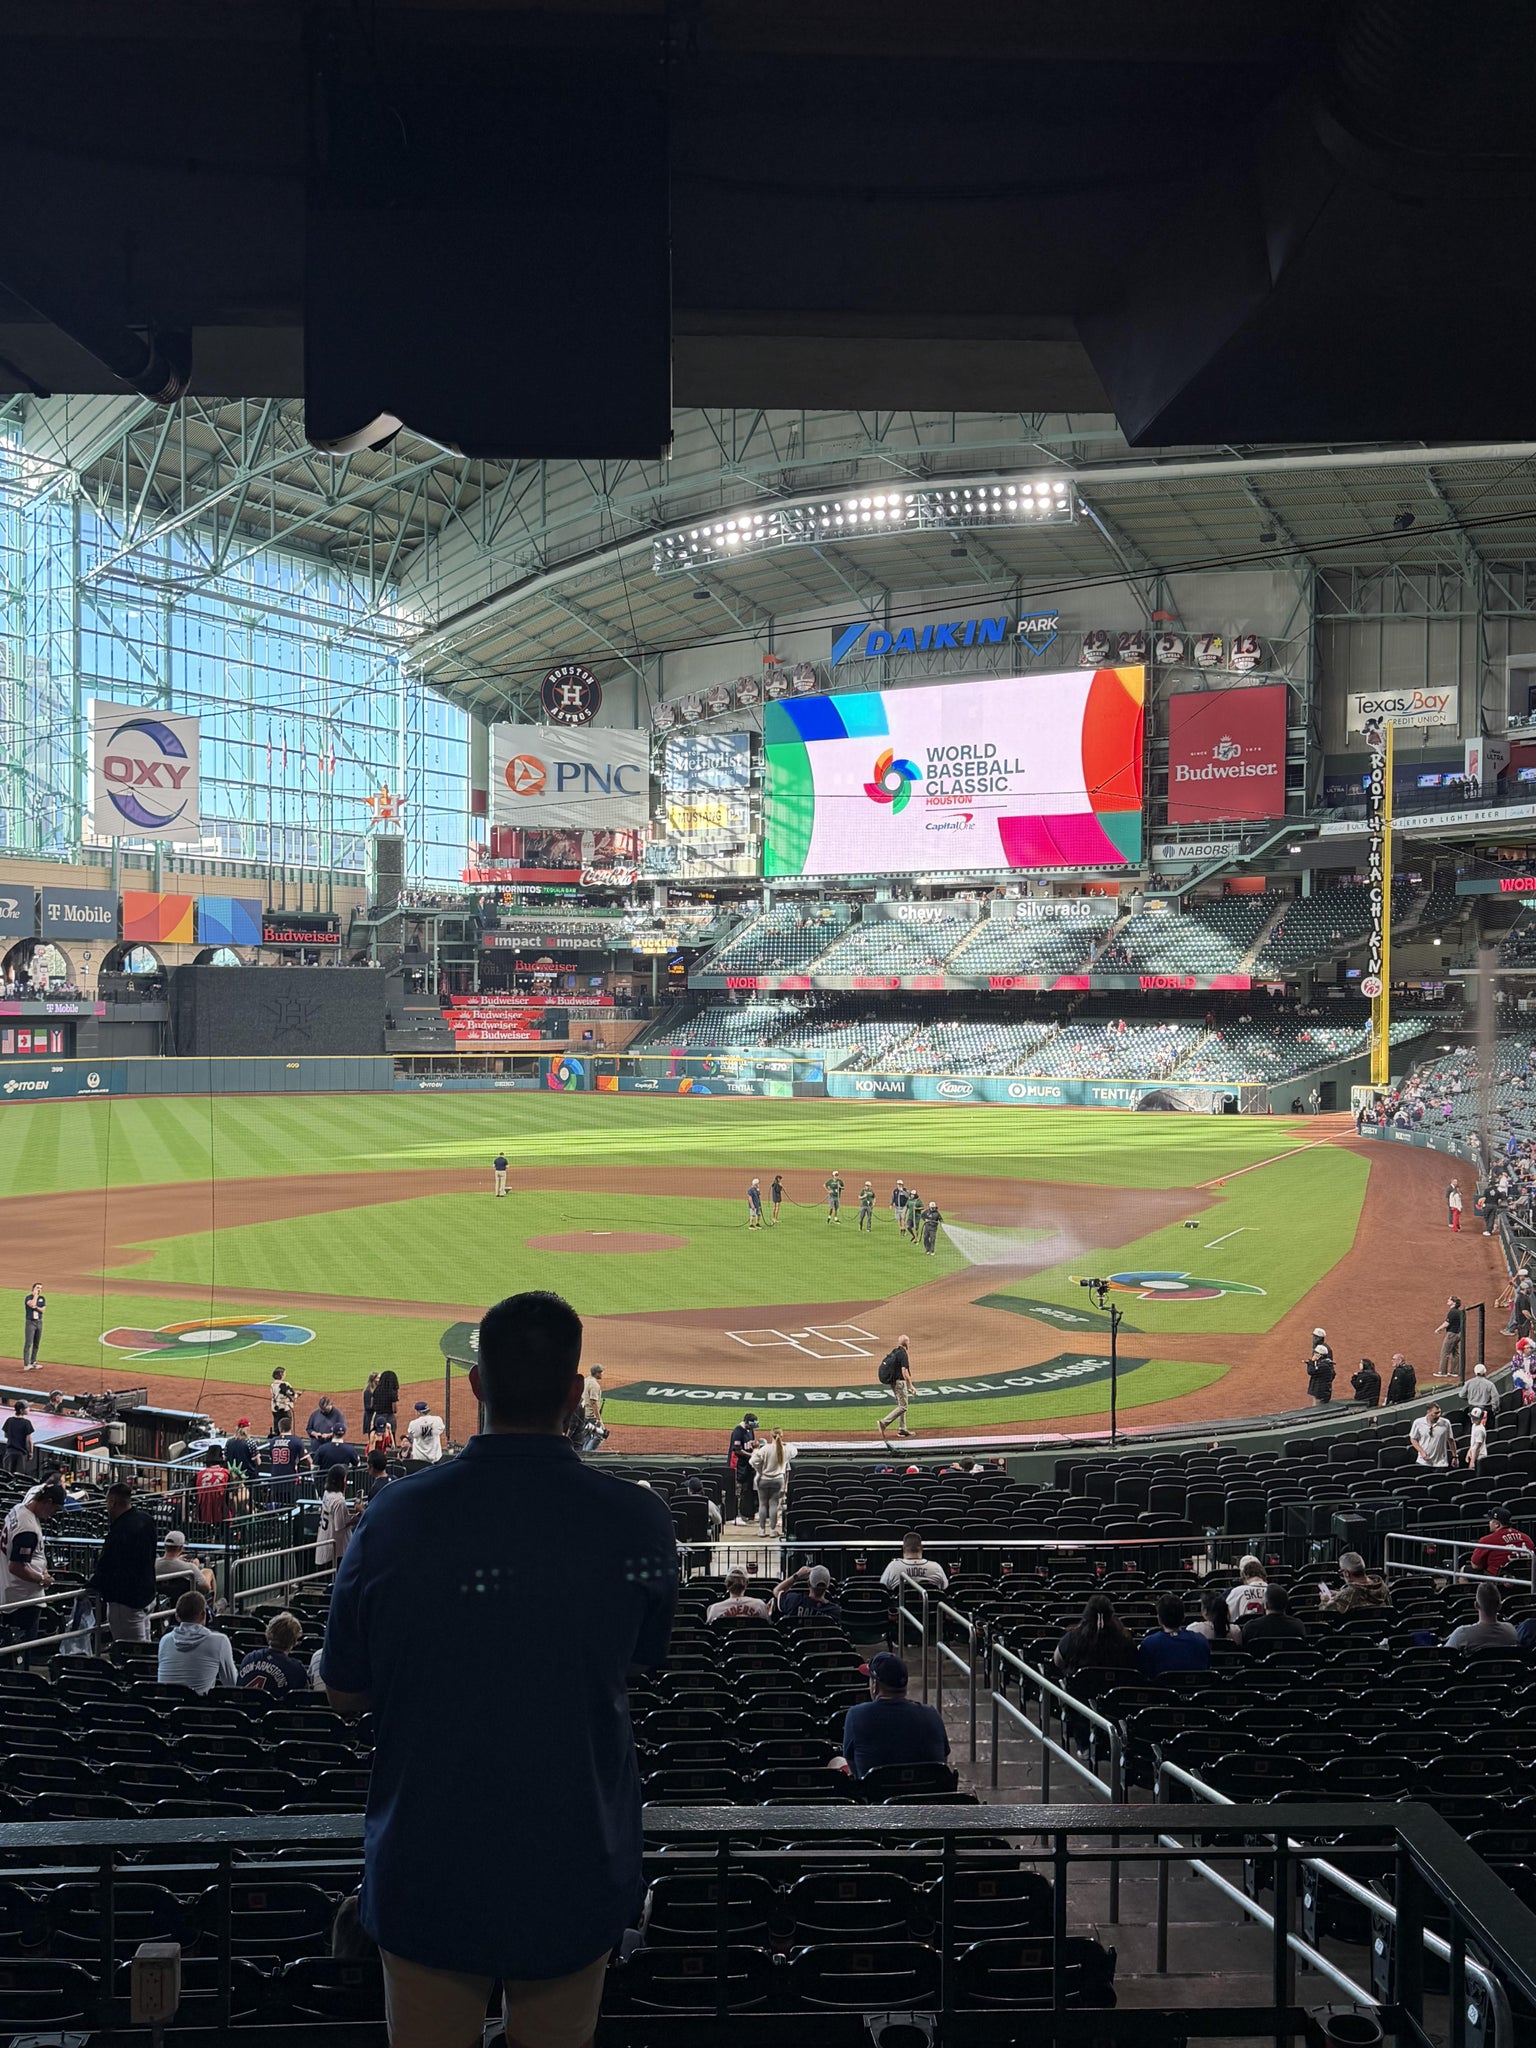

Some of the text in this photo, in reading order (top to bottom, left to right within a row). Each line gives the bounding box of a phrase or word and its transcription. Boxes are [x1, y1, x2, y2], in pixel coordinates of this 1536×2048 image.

[1017, 617, 1059, 633] PARK
[865, 617, 1008, 656] DAIKIN
[1083, 630, 1107, 649] 49
[1118, 630, 1143, 651] 24
[1163, 633, 1174, 651] 5
[1202, 632, 1214, 653] 7
[1234, 634, 1258, 654] 13
[549, 666, 595, 685] HOUSTON
[561, 685, 582, 705] H
[1355, 691, 1450, 714] Texas Bay
[550, 707, 592, 723] ASTROS
[1417, 715, 1447, 724] UNION
[926, 743, 997, 763] WORLD
[104, 756, 191, 789] OXY
[926, 758, 1025, 780] BASEBALL
[553, 762, 641, 795] PNC
[926, 776, 1008, 796] CLASSIC
[1370, 753, 1385, 810] ROOT
[926, 795, 973, 806] HOUSTON
[677, 811, 722, 823] MUSTANG
[1440, 814, 1468, 823] LIGHT
[1474, 811, 1499, 819] BEER
[1178, 845, 1229, 857] NABORS
[499, 886, 541, 894] HORNITOS
[64, 904, 112, 923] Mobile
[898, 905, 943, 920] Chevy
[1016, 902, 1091, 917] Silverado
[263, 929, 340, 943] Budweiser
[1367, 887, 1382, 974] CHIKIN
[494, 936, 542, 948] impact
[556, 936, 602, 948] impact
[514, 959, 578, 972] Budweiser
[726, 977, 769, 989] WORLD
[989, 976, 1040, 989] WORLD
[1139, 975, 1197, 989] WORLD
[481, 996, 529, 1005] Budweiser
[557, 997, 600, 1005] Budweiser
[473, 1010, 523, 1020] Budweiser
[467, 1020, 518, 1030] Budweiser
[481, 1030, 530, 1040] Budweiser
[727, 1083, 755, 1092] TENTIAL
[855, 1080, 905, 1093] KONAMI
[1027, 1082, 1060, 1097] MUFG
[1092, 1087, 1143, 1101] TENTIAL
[646, 1386, 796, 1401] WORLD
[1003, 1359, 1111, 1387] CLASSIC
[272, 1448, 290, 1464] 99
[1502, 1532, 1524, 1543] ORTIZ
[1244, 1588, 1265, 1601] SKE
[240, 1661, 288, 1688] CROW-ARMSTRONG
